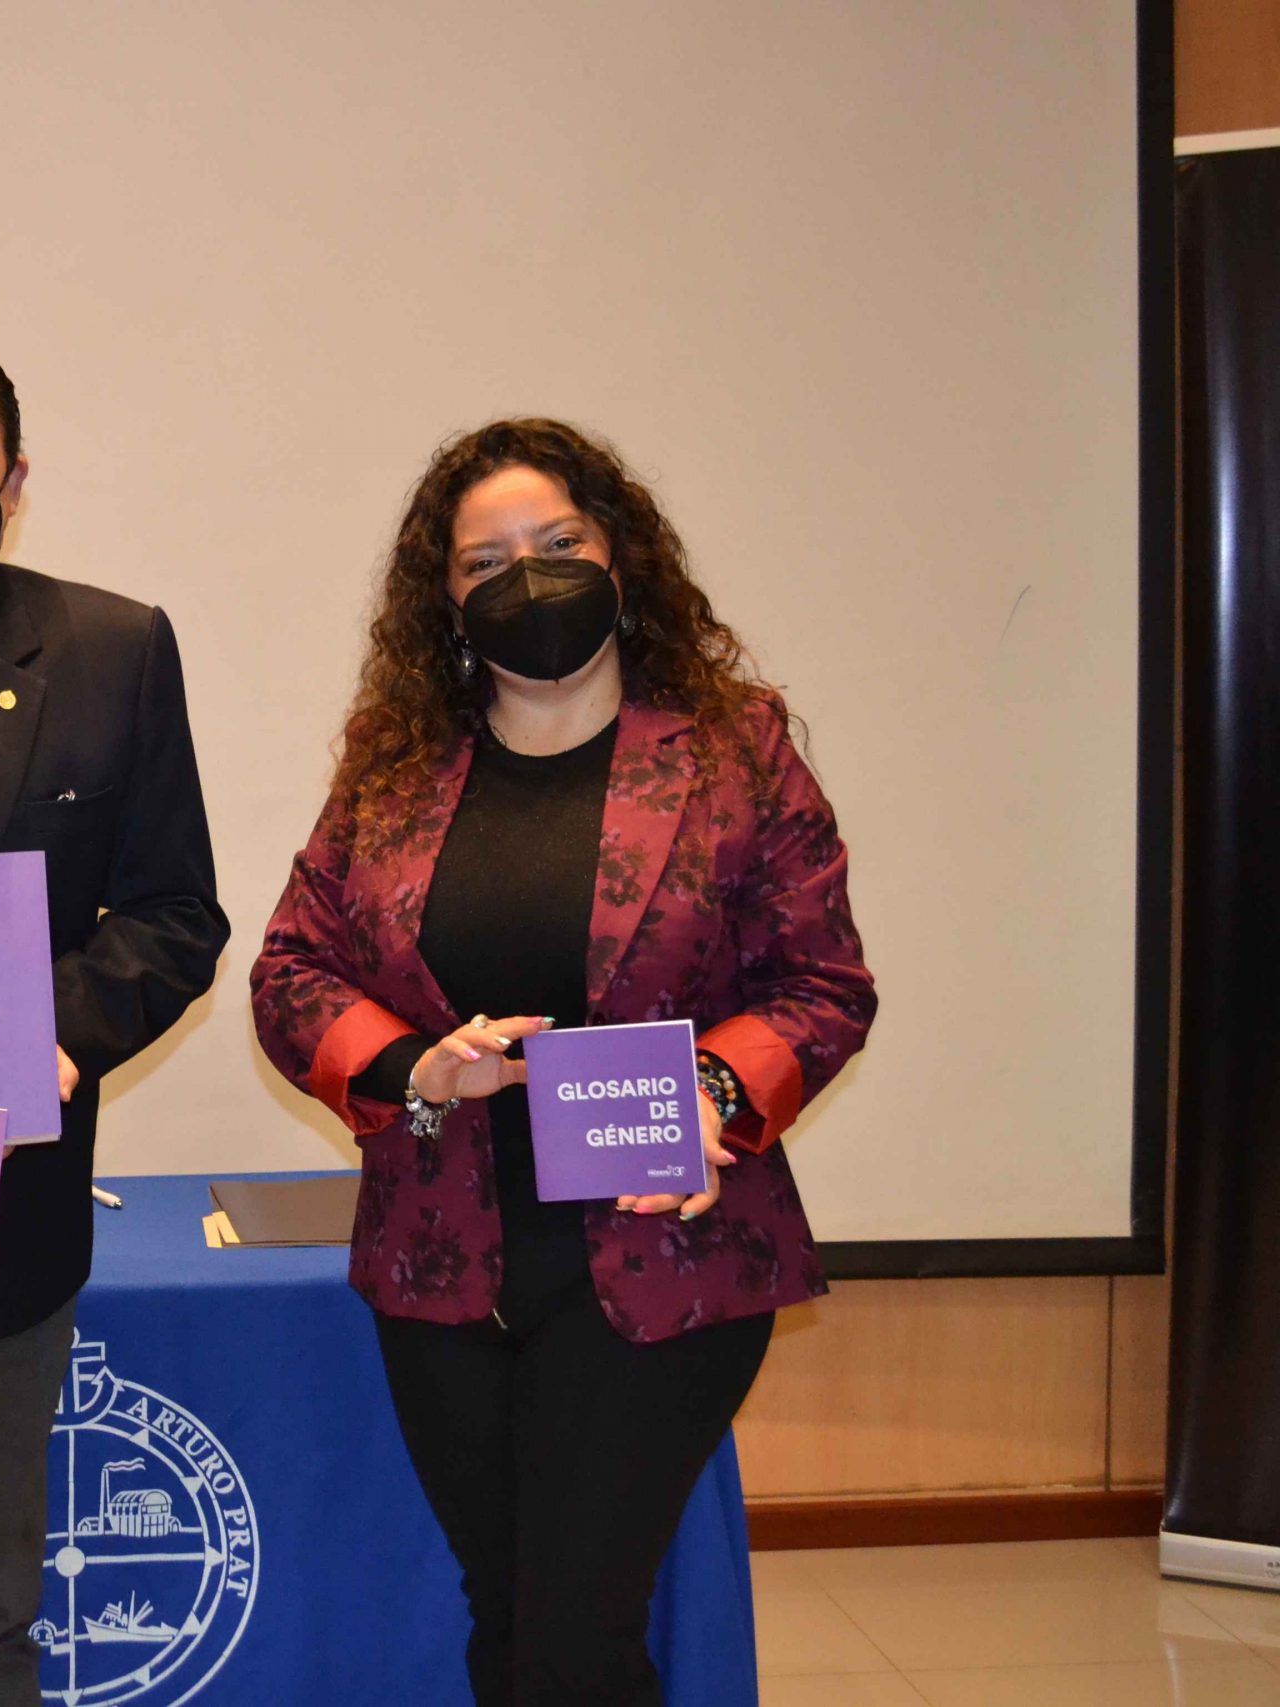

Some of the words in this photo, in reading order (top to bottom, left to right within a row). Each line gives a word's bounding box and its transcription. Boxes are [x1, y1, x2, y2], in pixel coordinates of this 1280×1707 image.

[557, 1076, 678, 1101] GLOSARIO
[649, 1100, 680, 1120] DE
[586, 1123, 683, 1147] GÉNERO
[126, 1396, 236, 1495] ARTURO
[222, 1505, 252, 1599] PRAT
